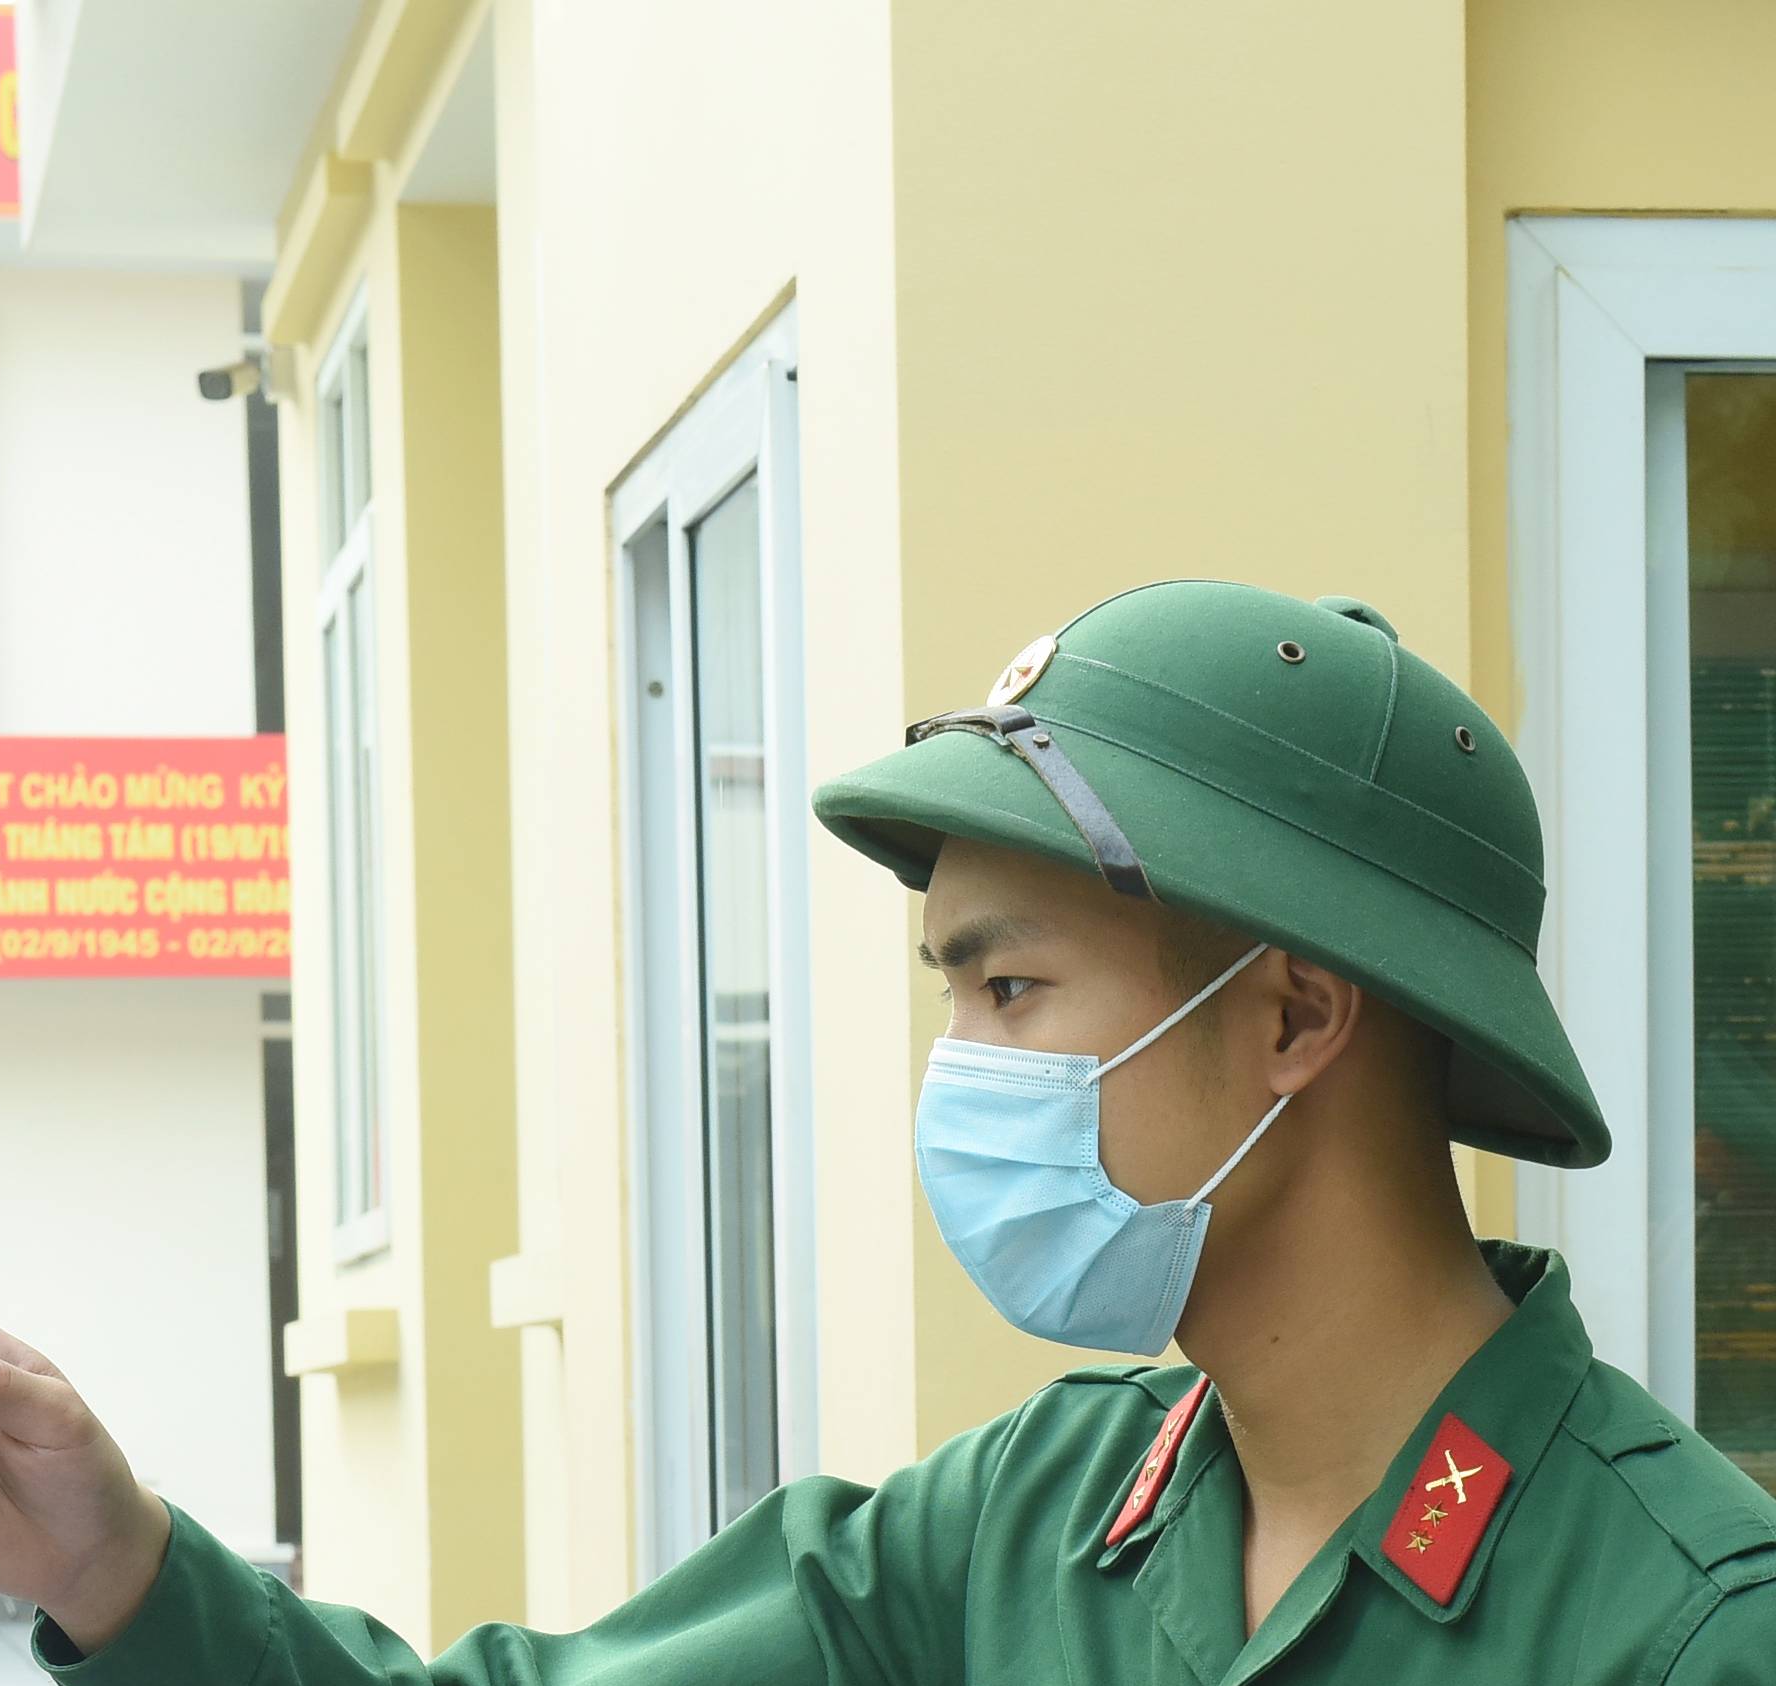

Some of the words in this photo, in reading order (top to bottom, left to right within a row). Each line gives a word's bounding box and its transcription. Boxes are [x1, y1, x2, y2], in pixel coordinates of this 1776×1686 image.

[21, 763, 116, 809] CHÀO
[126, 763, 222, 809] MỪNG
[4, 818, 102, 861] THÁNG
[109, 818, 173, 861] TÁM
[57, 870, 138, 916] NƯỚC
[146, 873, 226, 921] CỘNG
[188, 928, 291, 961] 02/9/2
